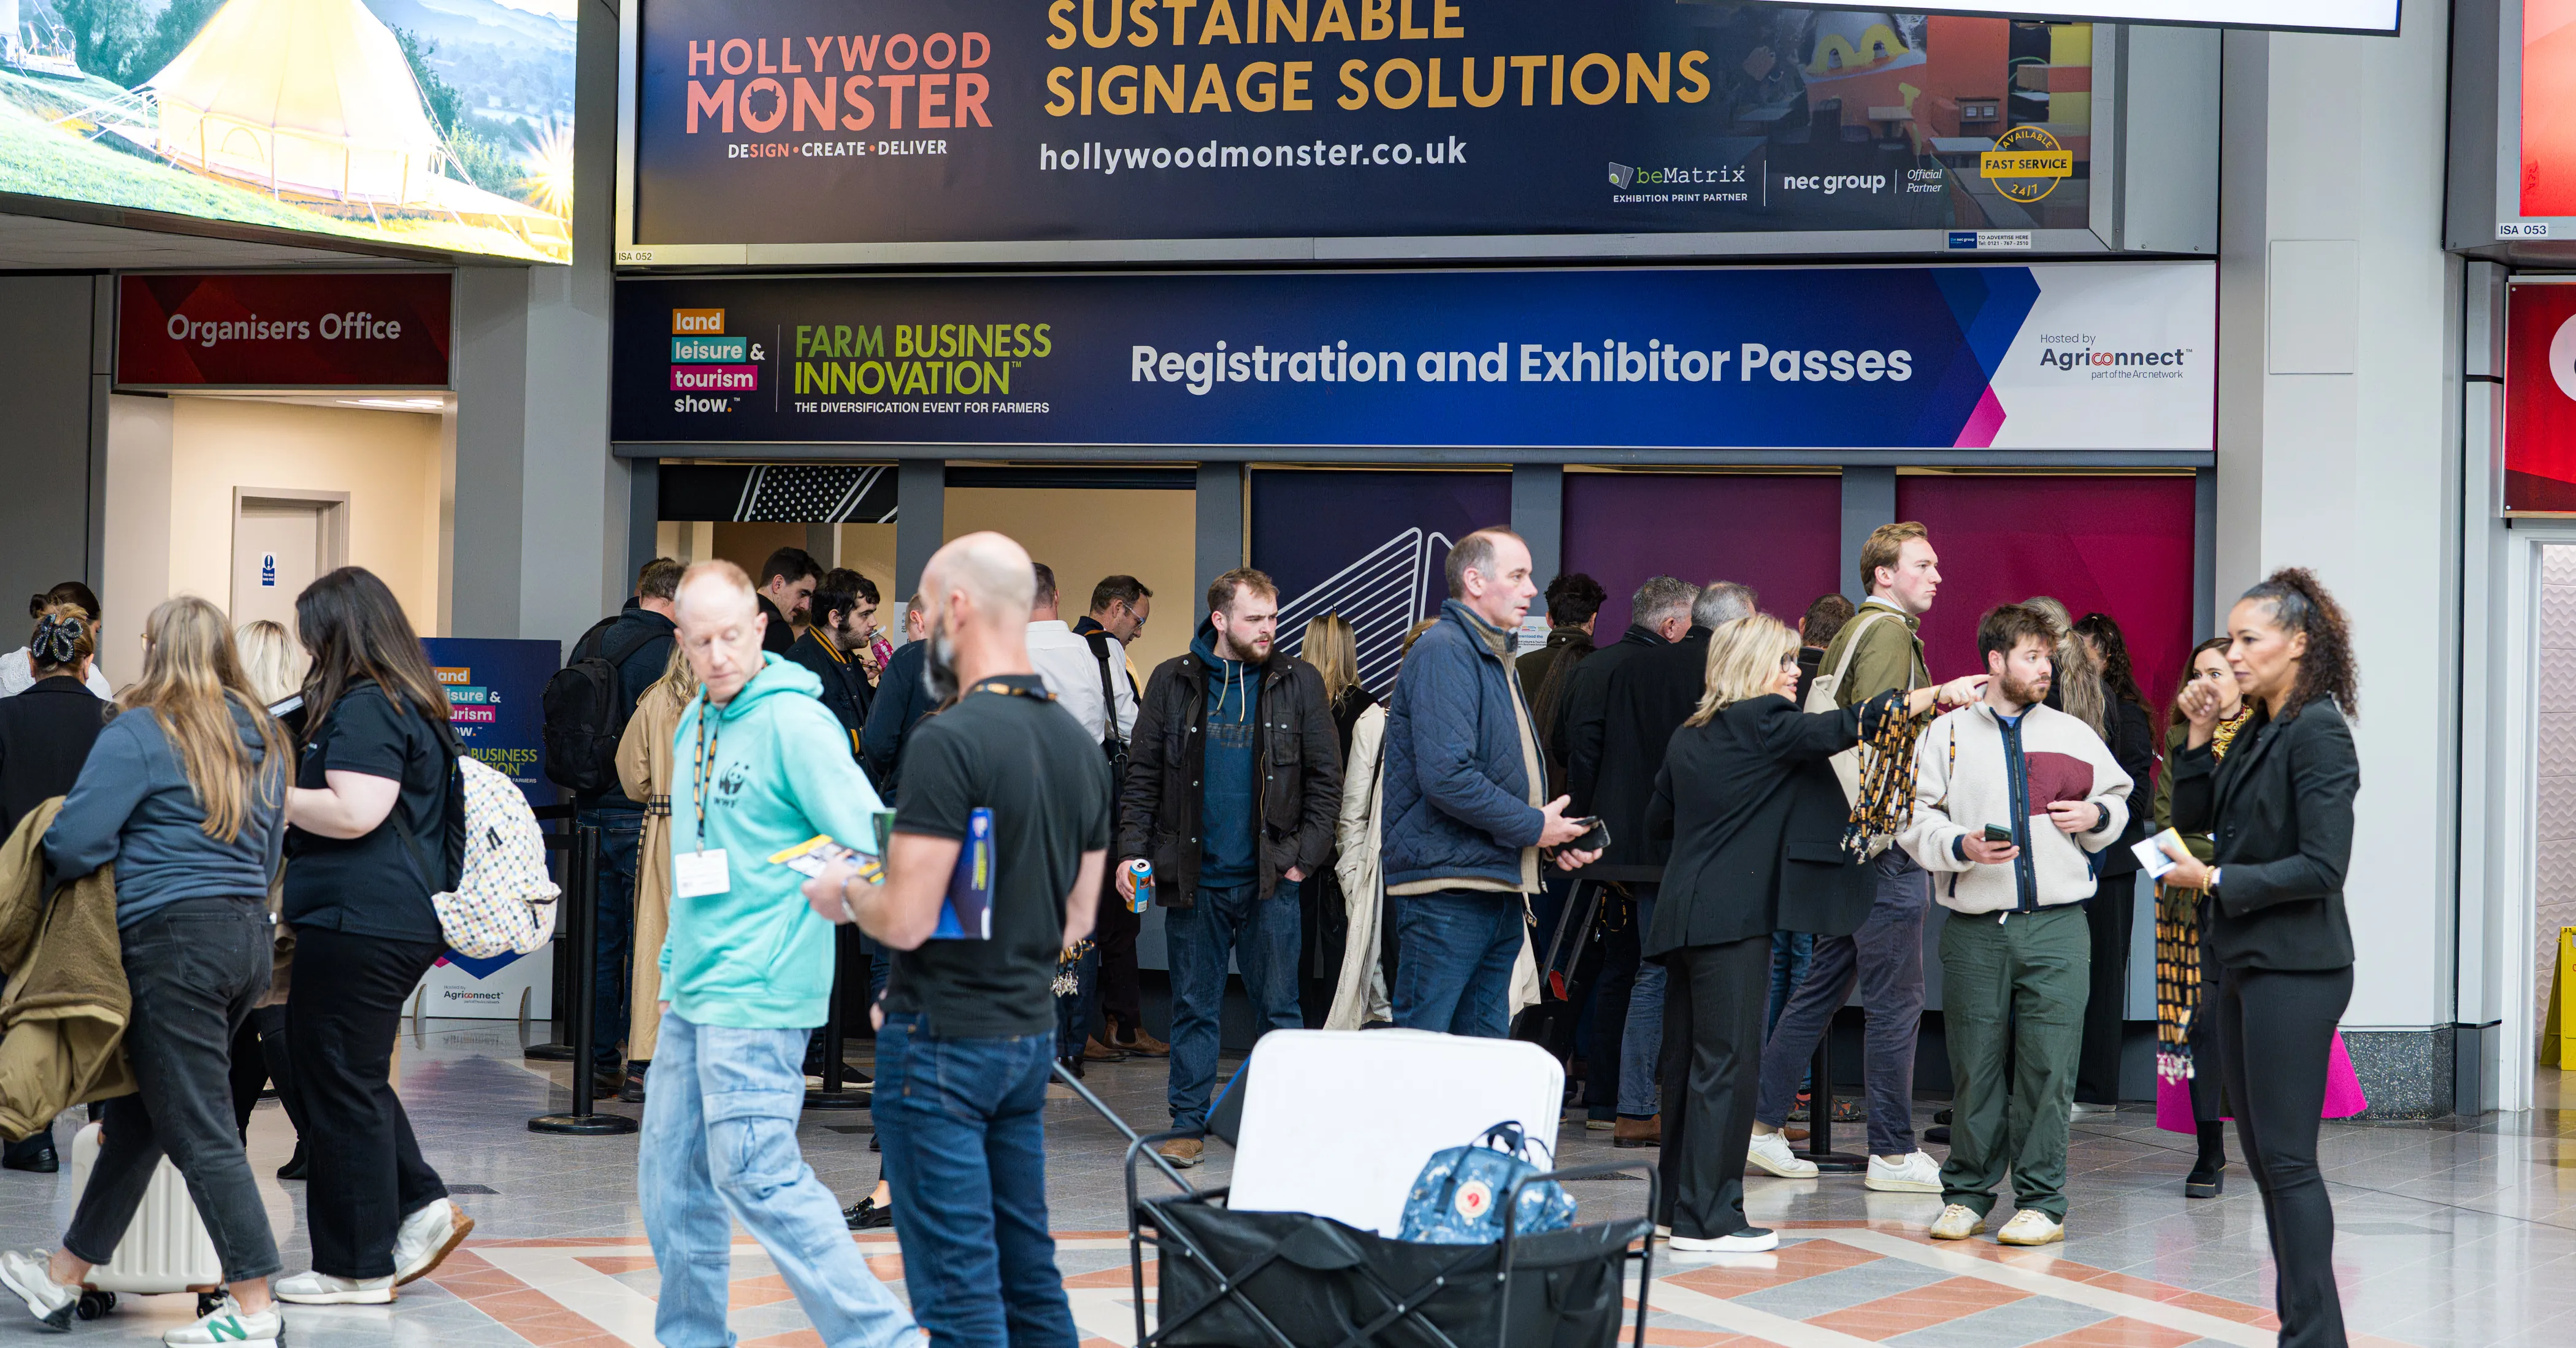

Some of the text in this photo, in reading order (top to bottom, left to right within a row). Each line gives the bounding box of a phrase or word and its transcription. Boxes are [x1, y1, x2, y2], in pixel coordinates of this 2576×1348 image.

[1046, 0, 1465, 49] SUSTAINABLE
[689, 32, 990, 76] HOLLYWOOD
[1044, 50, 1711, 117] SIGNAGE SOLUTIONS
[686, 72, 993, 134] MONSTER
[2003, 131, 2053, 148] AVAILABLE
[728, 140, 947, 158] DESIGN CREATE DELIVER
[1040, 136, 1467, 175] hollywoodmonster.co.uk
[1985, 159, 2067, 169] FAST SERVICE
[1907, 169, 1943, 180] Official
[1784, 173, 1886, 194] nec group
[1906, 182, 1942, 193] Partner
[2011, 184, 2037, 197] 24/7
[1613, 194, 1669, 203] EXHIBITION
[2500, 225, 2547, 235] ISA 053
[618, 252, 652, 261] ISA 052
[167, 311, 401, 348] Organisers Office
[675, 312, 721, 331] land
[795, 323, 1052, 358] FARM BUSINESS
[2041, 334, 2096, 345] Hosted by
[675, 341, 765, 361] leisure &
[1131, 339, 1913, 396] Registration and Exhibitor Passes
[2091, 370, 2183, 381] part of the Arc network
[675, 370, 753, 388] tourism
[795, 402, 1049, 413] THE DIVERSIFICATION EVENT FOR FARMERS
[447, 689, 501, 703] isure &
[450, 708, 493, 721] urism
[471, 748, 537, 762] BUSINESS
